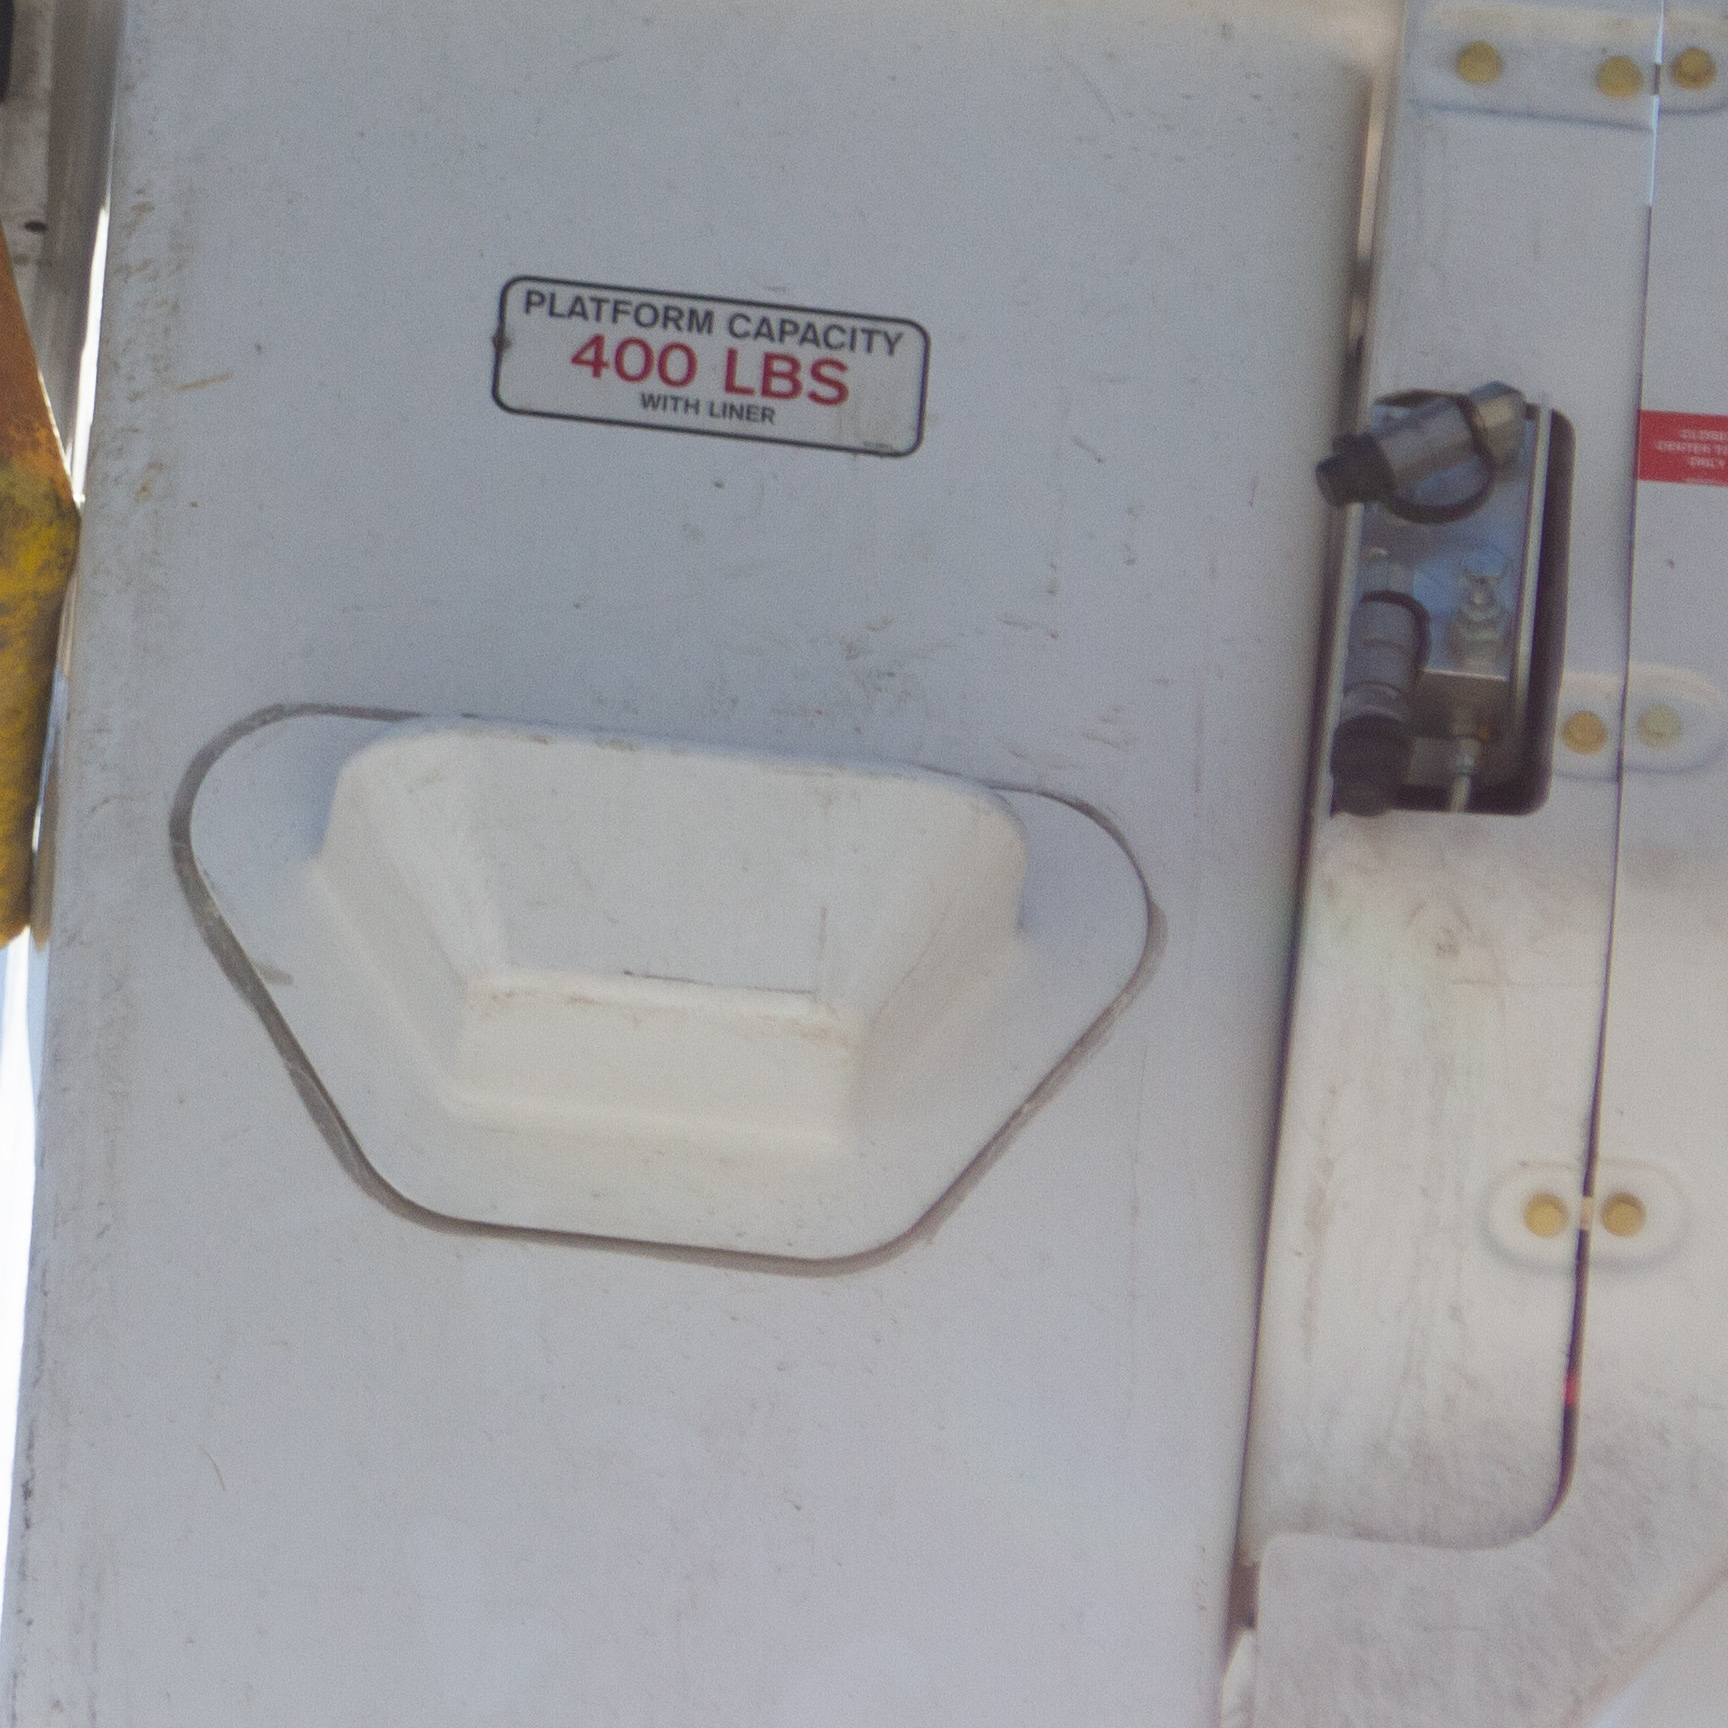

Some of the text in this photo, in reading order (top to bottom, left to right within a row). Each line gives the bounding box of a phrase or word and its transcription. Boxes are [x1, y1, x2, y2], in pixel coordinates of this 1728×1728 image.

[523, 289, 904, 357] PLATFORM CAPACITY
[570, 333, 850, 407] 400 LBS
[640, 391, 776, 425] WITH LINER
